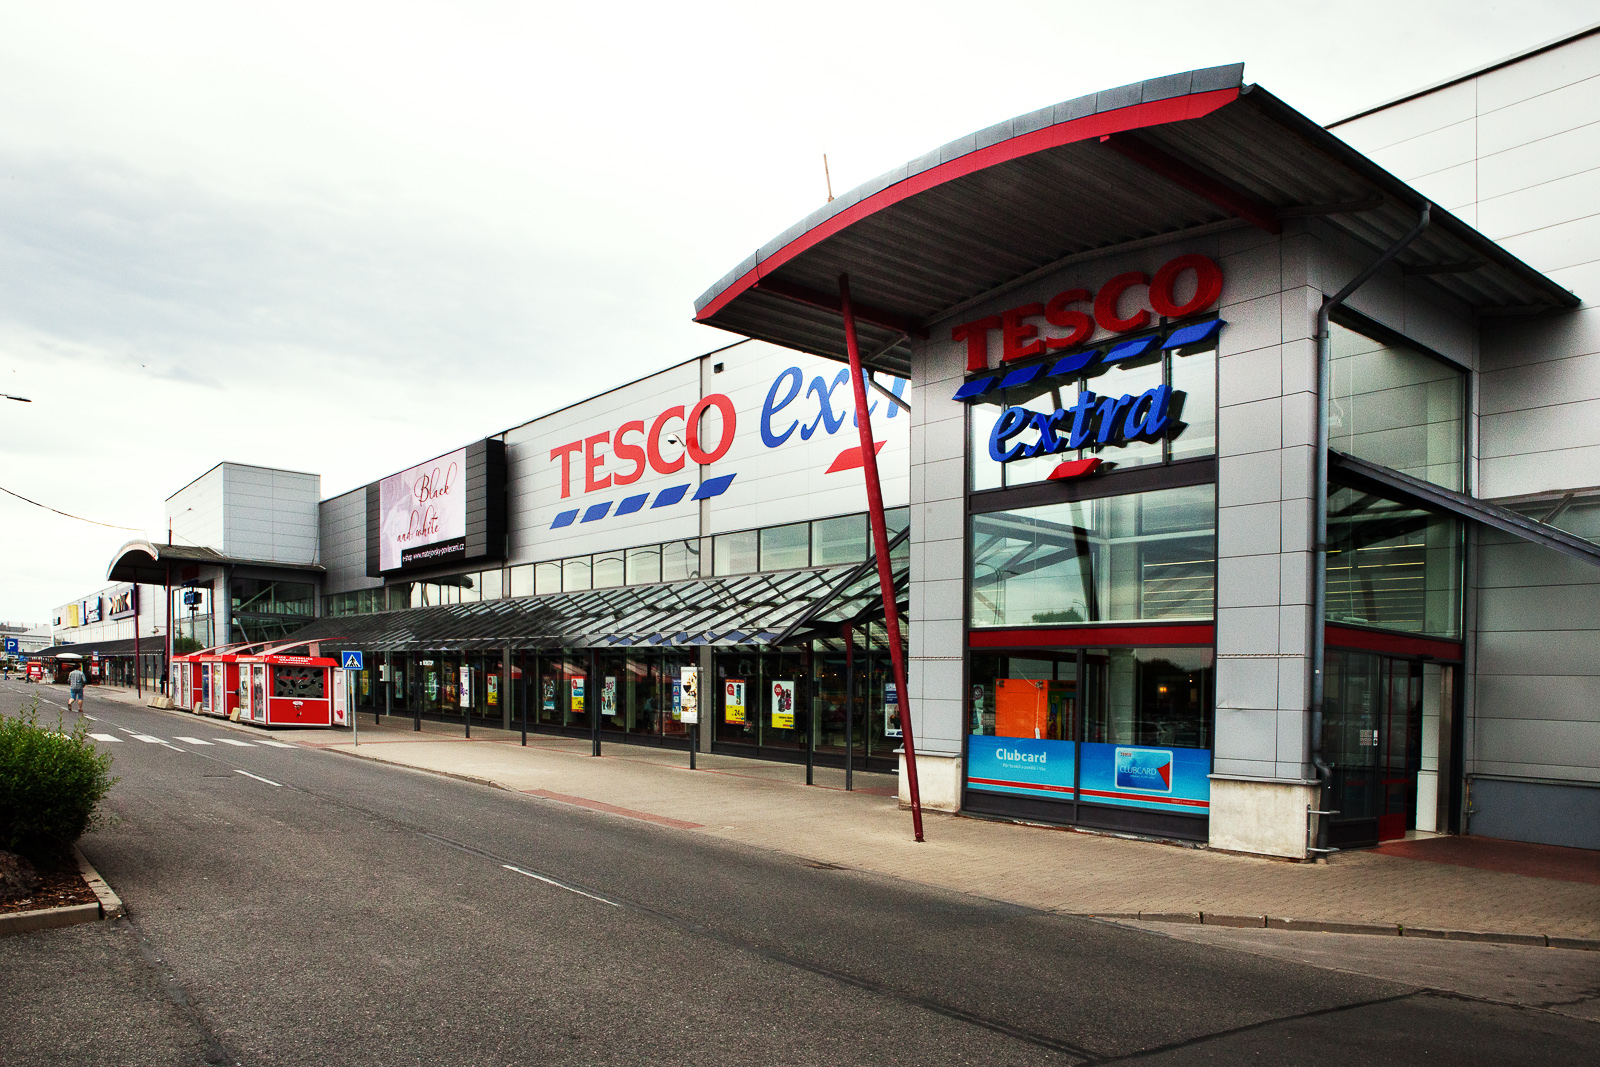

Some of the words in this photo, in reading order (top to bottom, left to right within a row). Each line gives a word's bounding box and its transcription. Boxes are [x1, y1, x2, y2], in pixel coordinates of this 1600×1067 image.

[951, 253, 1224, 373] TESCO
[988, 384, 1174, 463] extra
[549, 393, 737, 500] TESCO
[414, 462, 457, 506] Black
[397, 509, 420, 542] and
[416, 504, 440, 537] white
[7, 641, 16, 650] P
[995, 748, 1047, 764] Clubcard
[1120, 766, 1157, 776] CLUBCARD
